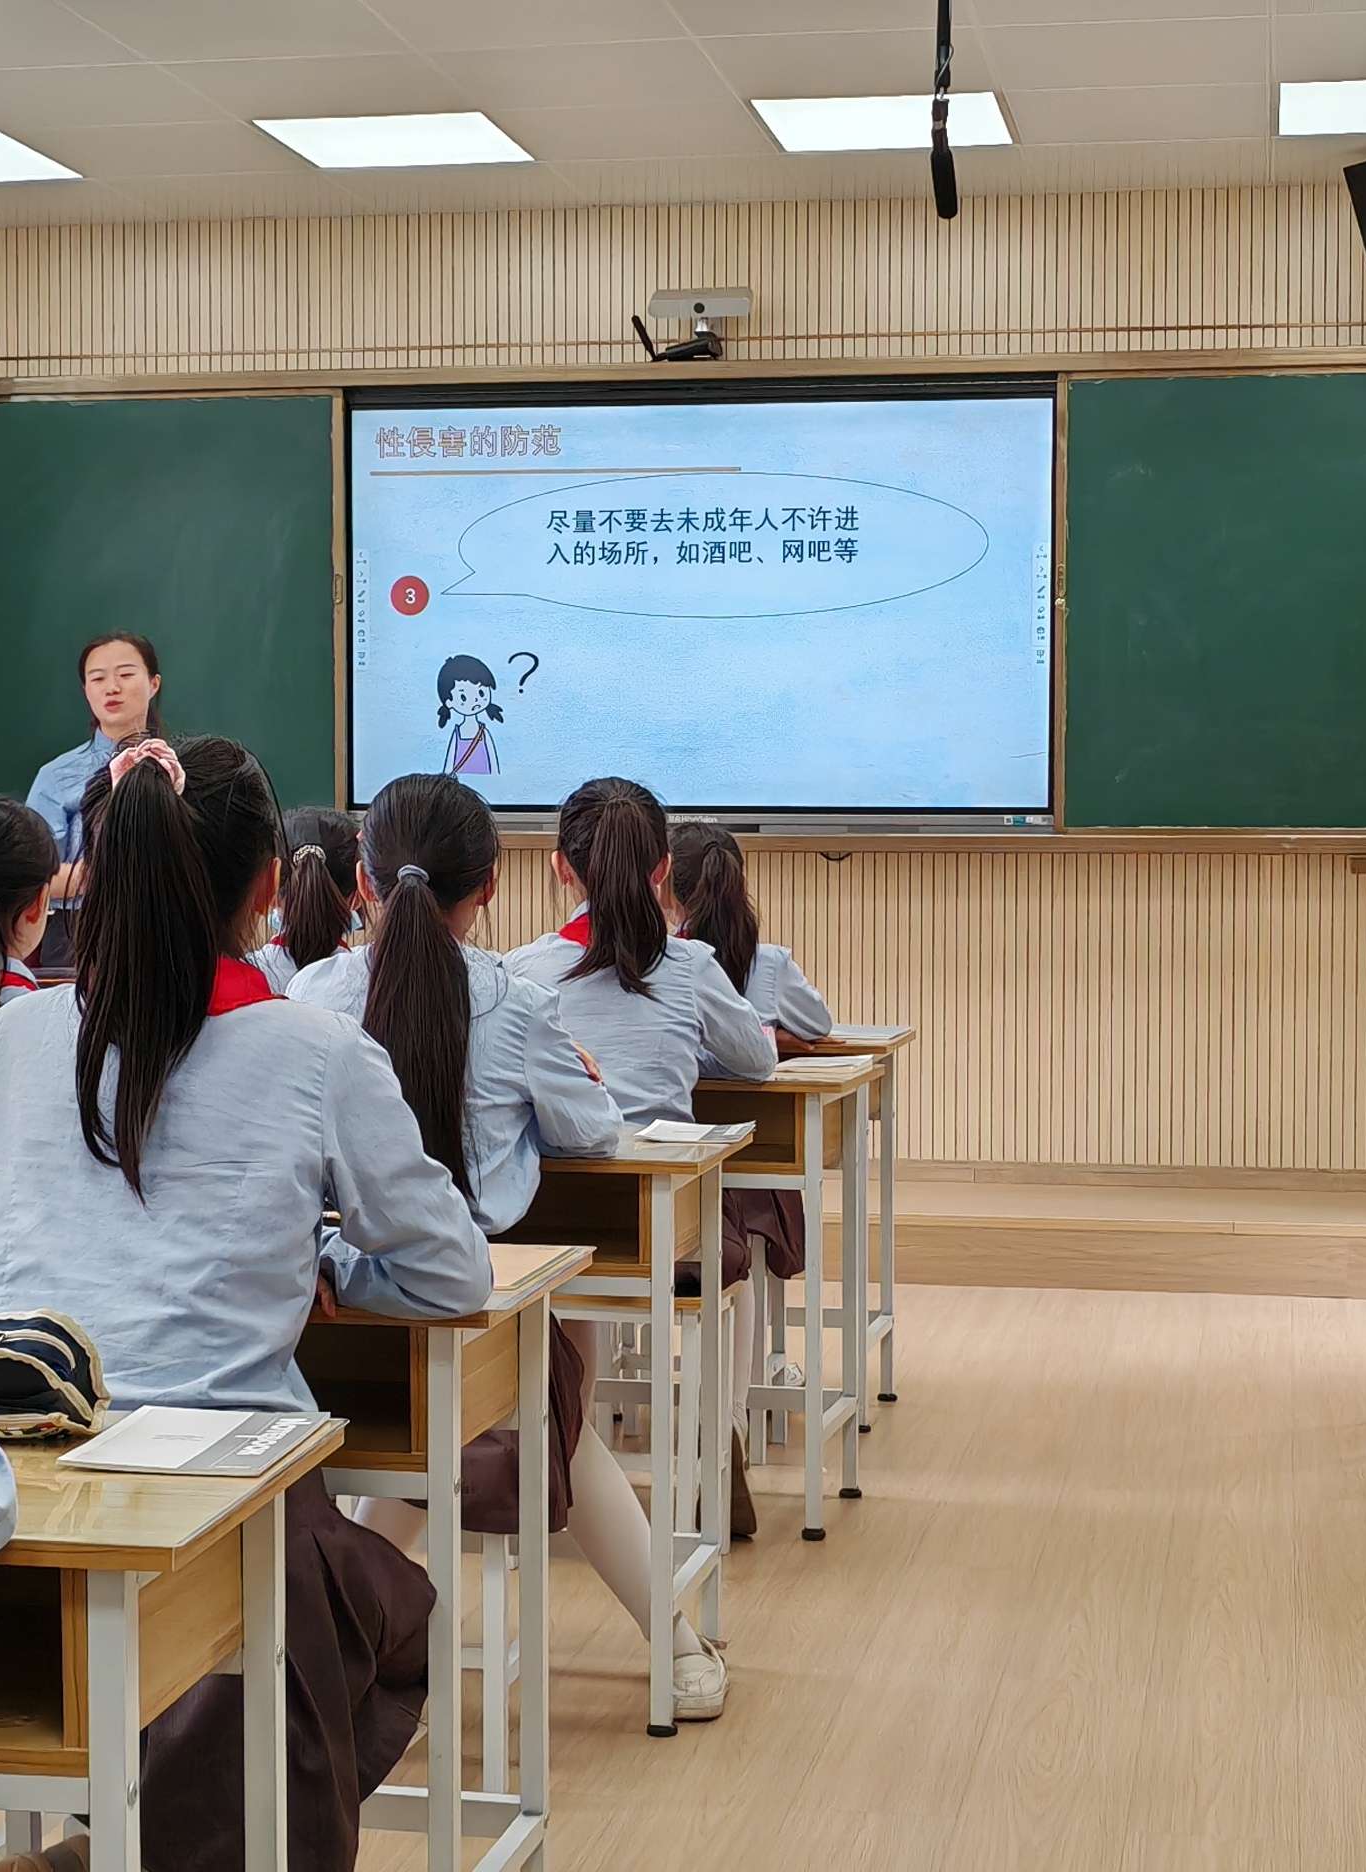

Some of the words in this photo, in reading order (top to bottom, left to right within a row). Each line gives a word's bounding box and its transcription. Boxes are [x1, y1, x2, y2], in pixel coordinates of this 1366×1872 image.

[375, 424, 562, 459] 性侵害的防范
[546, 505, 860, 534] 尽量不要去未成年人不许进
[546, 537, 860, 566] 入的场所，如酒吧、网吧等
[404, 587, 417, 604] 3
